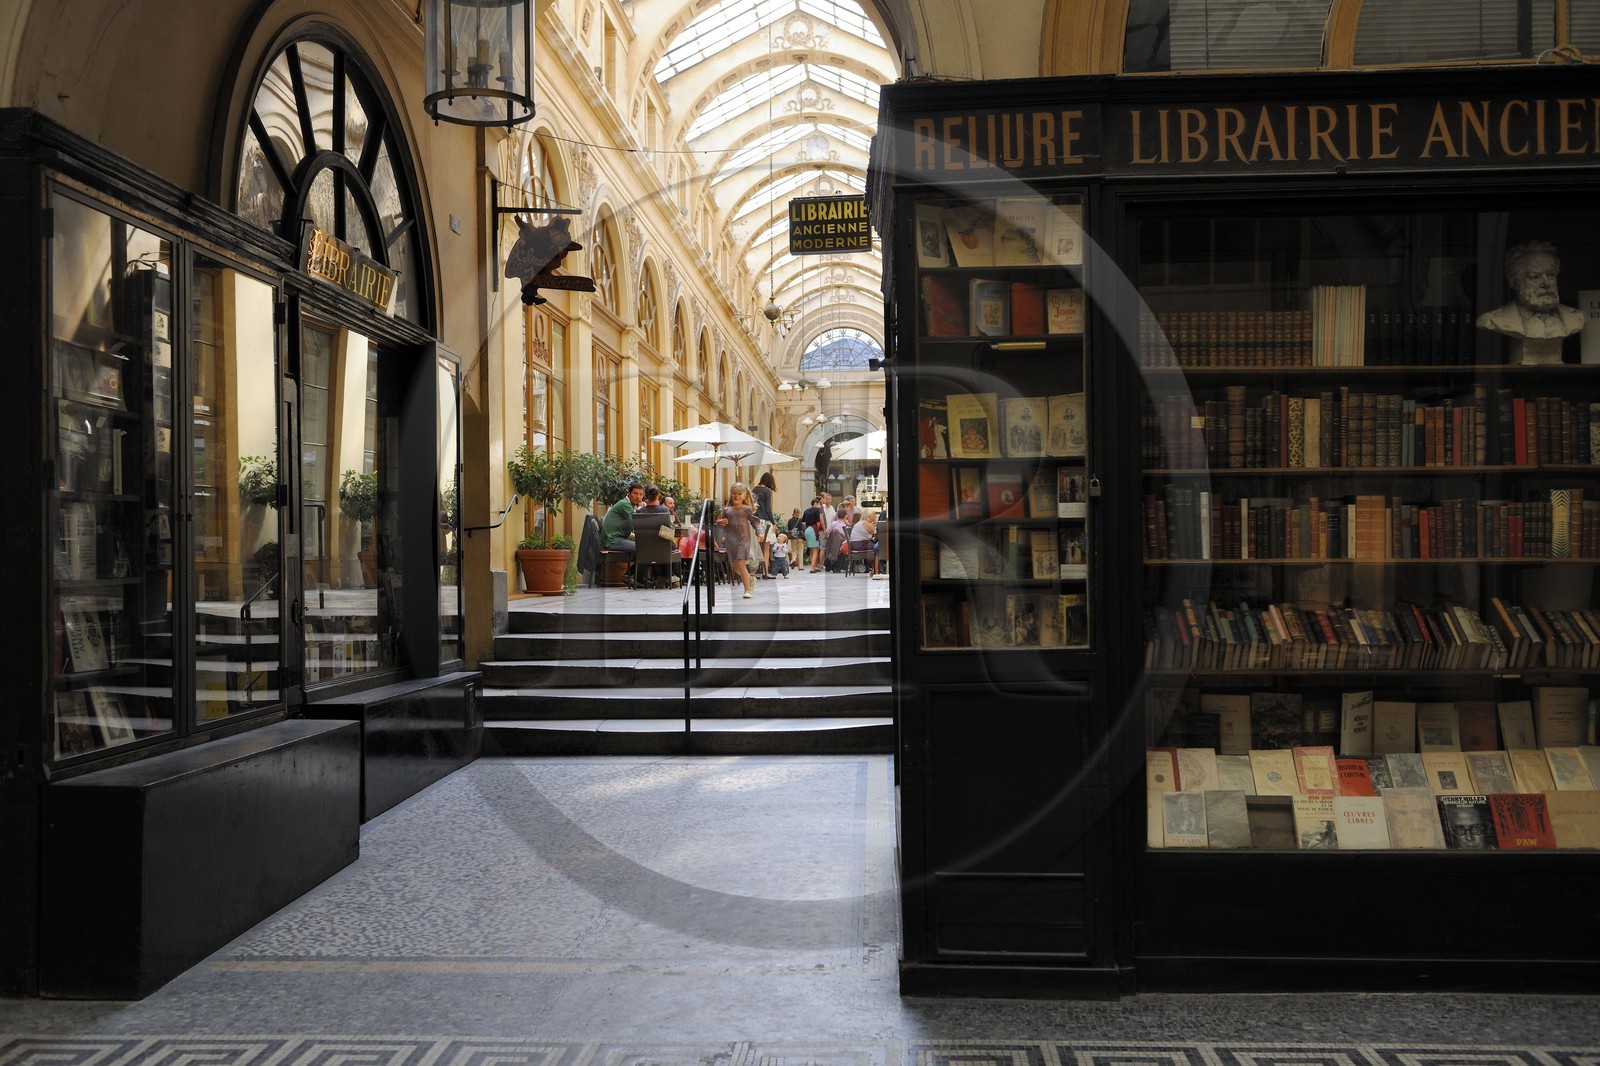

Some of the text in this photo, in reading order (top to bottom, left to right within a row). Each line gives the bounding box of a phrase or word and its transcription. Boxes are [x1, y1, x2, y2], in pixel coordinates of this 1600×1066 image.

[914, 110, 1083, 172] RELIURE
[1129, 97, 1600, 166] LIBRAIRIE ANCIE
[791, 200, 868, 222] LIBRAIRIE
[793, 222, 868, 236] ANCIENNE
[792, 236, 868, 250] MODERNE
[308, 228, 391, 309] LIBRAIRIE
